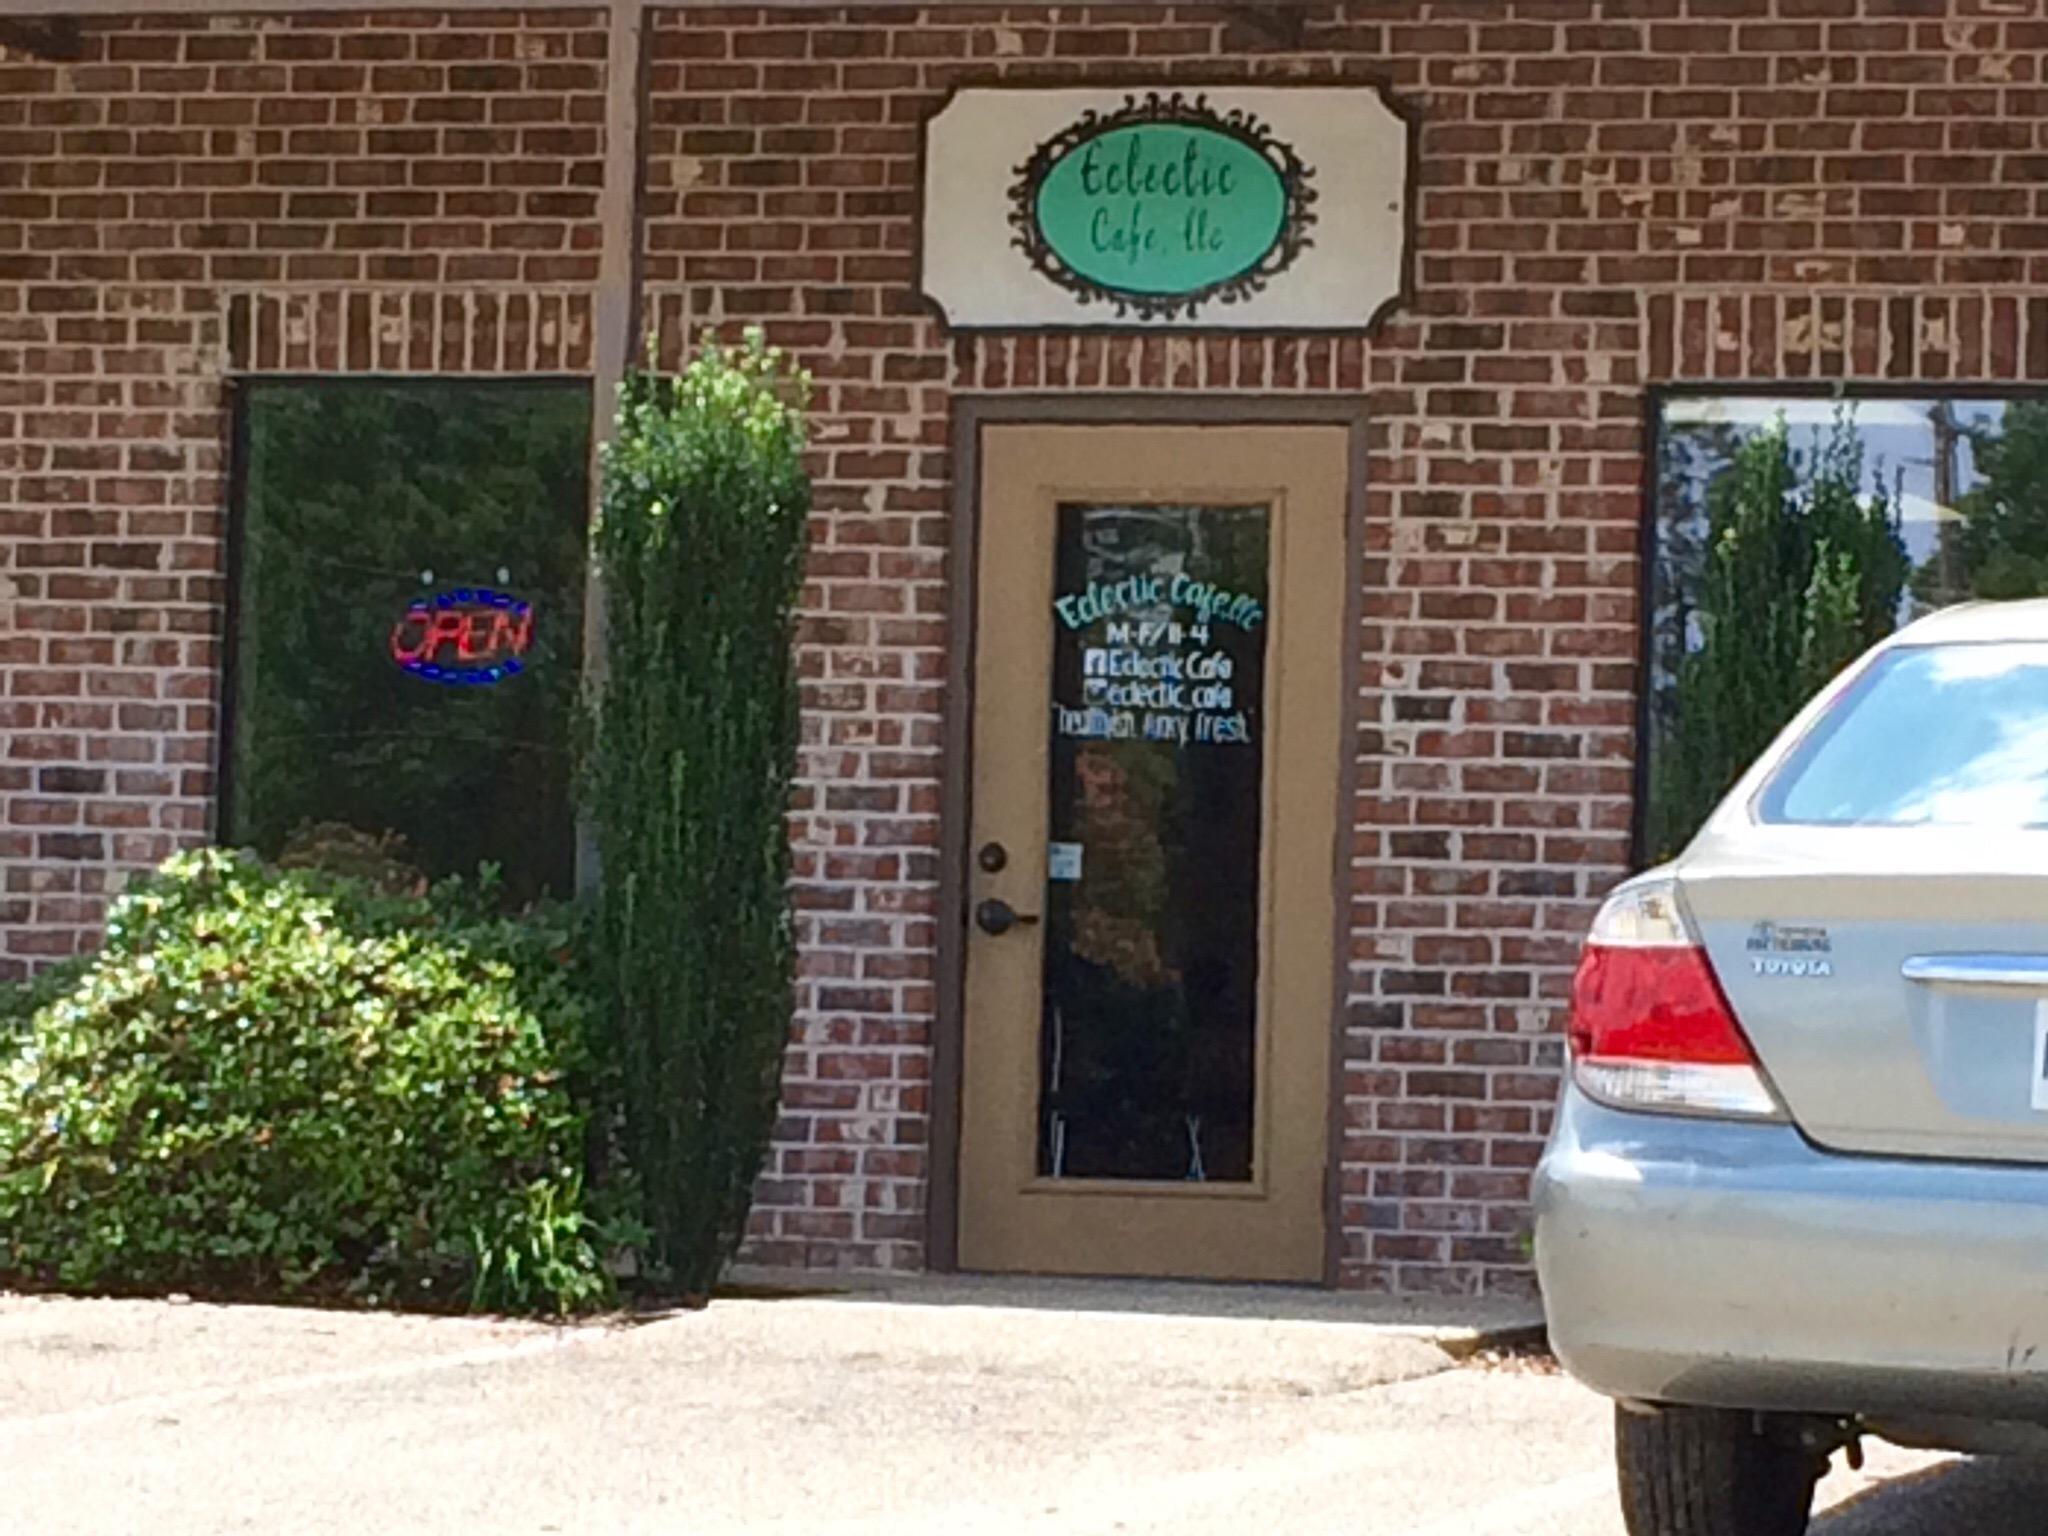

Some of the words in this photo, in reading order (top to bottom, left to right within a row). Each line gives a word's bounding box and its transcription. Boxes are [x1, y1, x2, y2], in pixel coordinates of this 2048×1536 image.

[1081, 133, 1236, 197] Eclectic
[1184, 206, 1224, 252] llc
[1054, 573, 1164, 629] Eclectic
[389, 603, 533, 662] OPEN
[1752, 956, 1832, 976] TOYOTA
